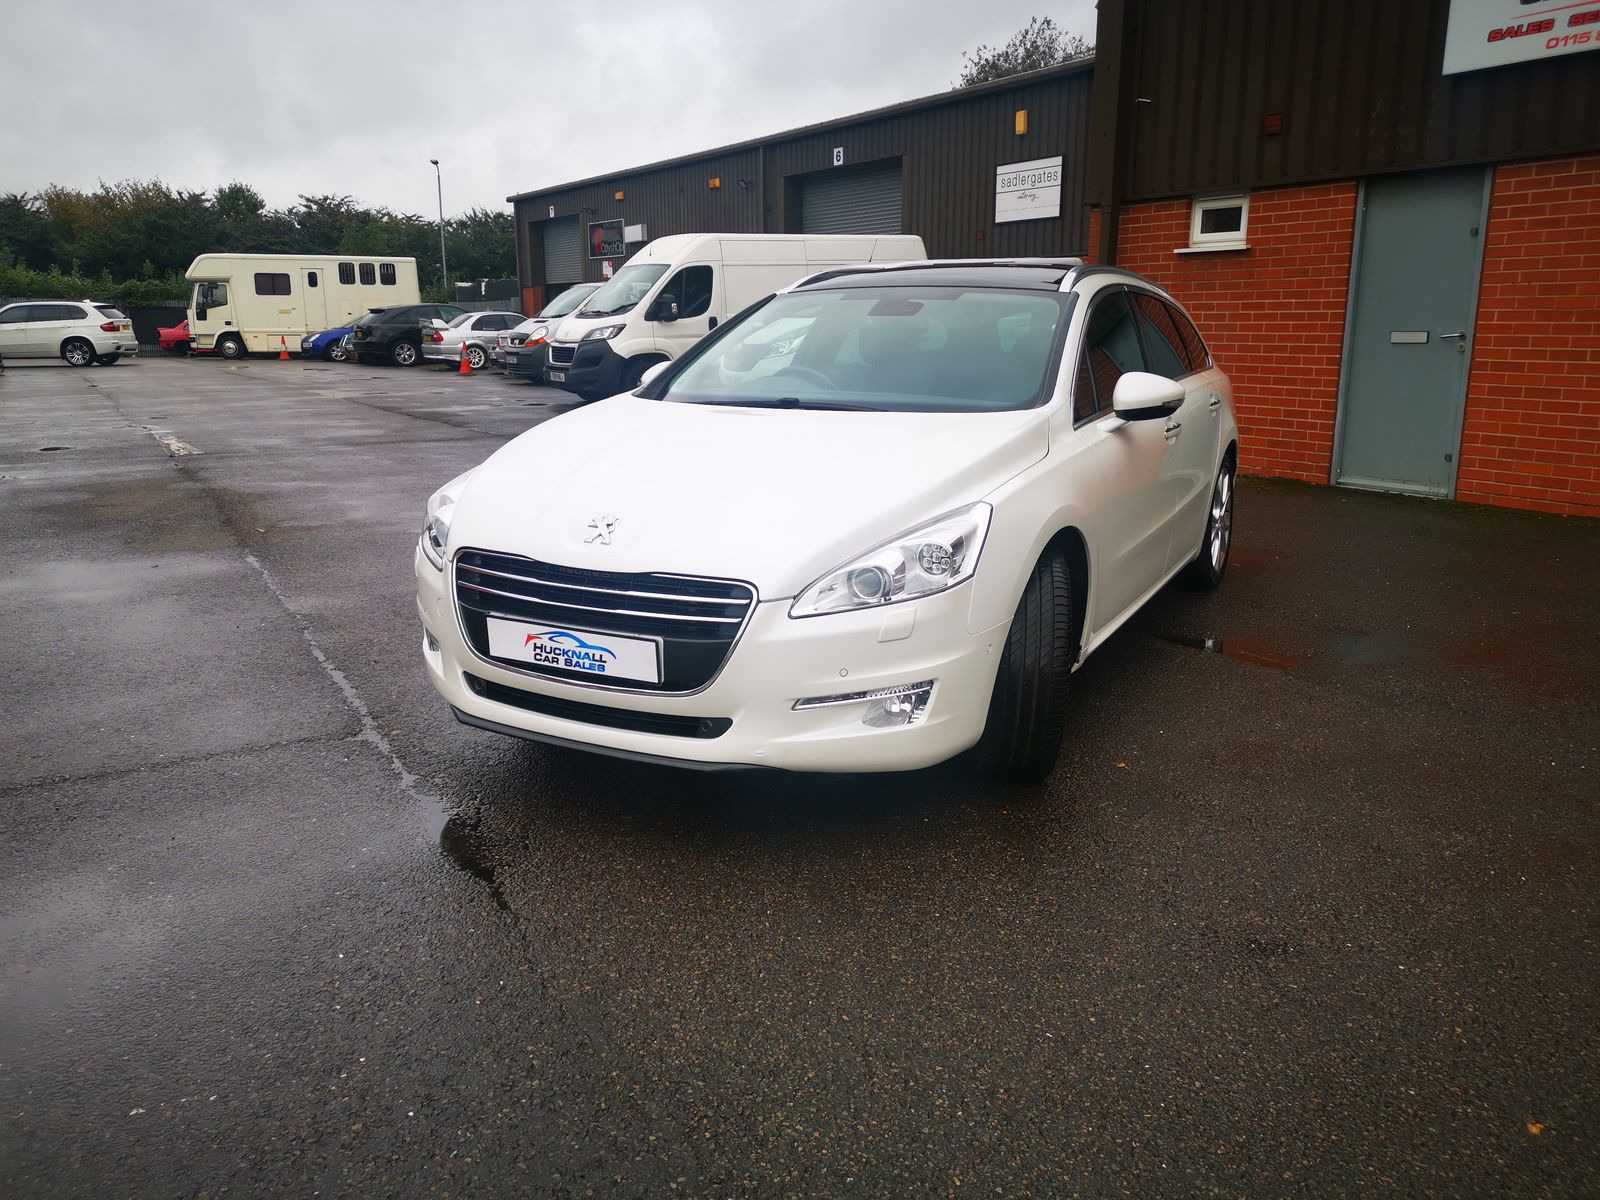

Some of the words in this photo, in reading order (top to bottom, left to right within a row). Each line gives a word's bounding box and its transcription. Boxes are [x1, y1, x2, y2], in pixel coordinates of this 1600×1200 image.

[1487, 18, 1555, 42] SALES
[1567, 10, 1600, 27] SE
[1546, 31, 1592, 49] 0115
[835, 150, 841, 163] 6
[1000, 169, 1058, 188] sadlergates
[533, 642, 607, 663] HUCKNALL
[533, 652, 559, 665] CAR
[564, 658, 606, 673] SALES
